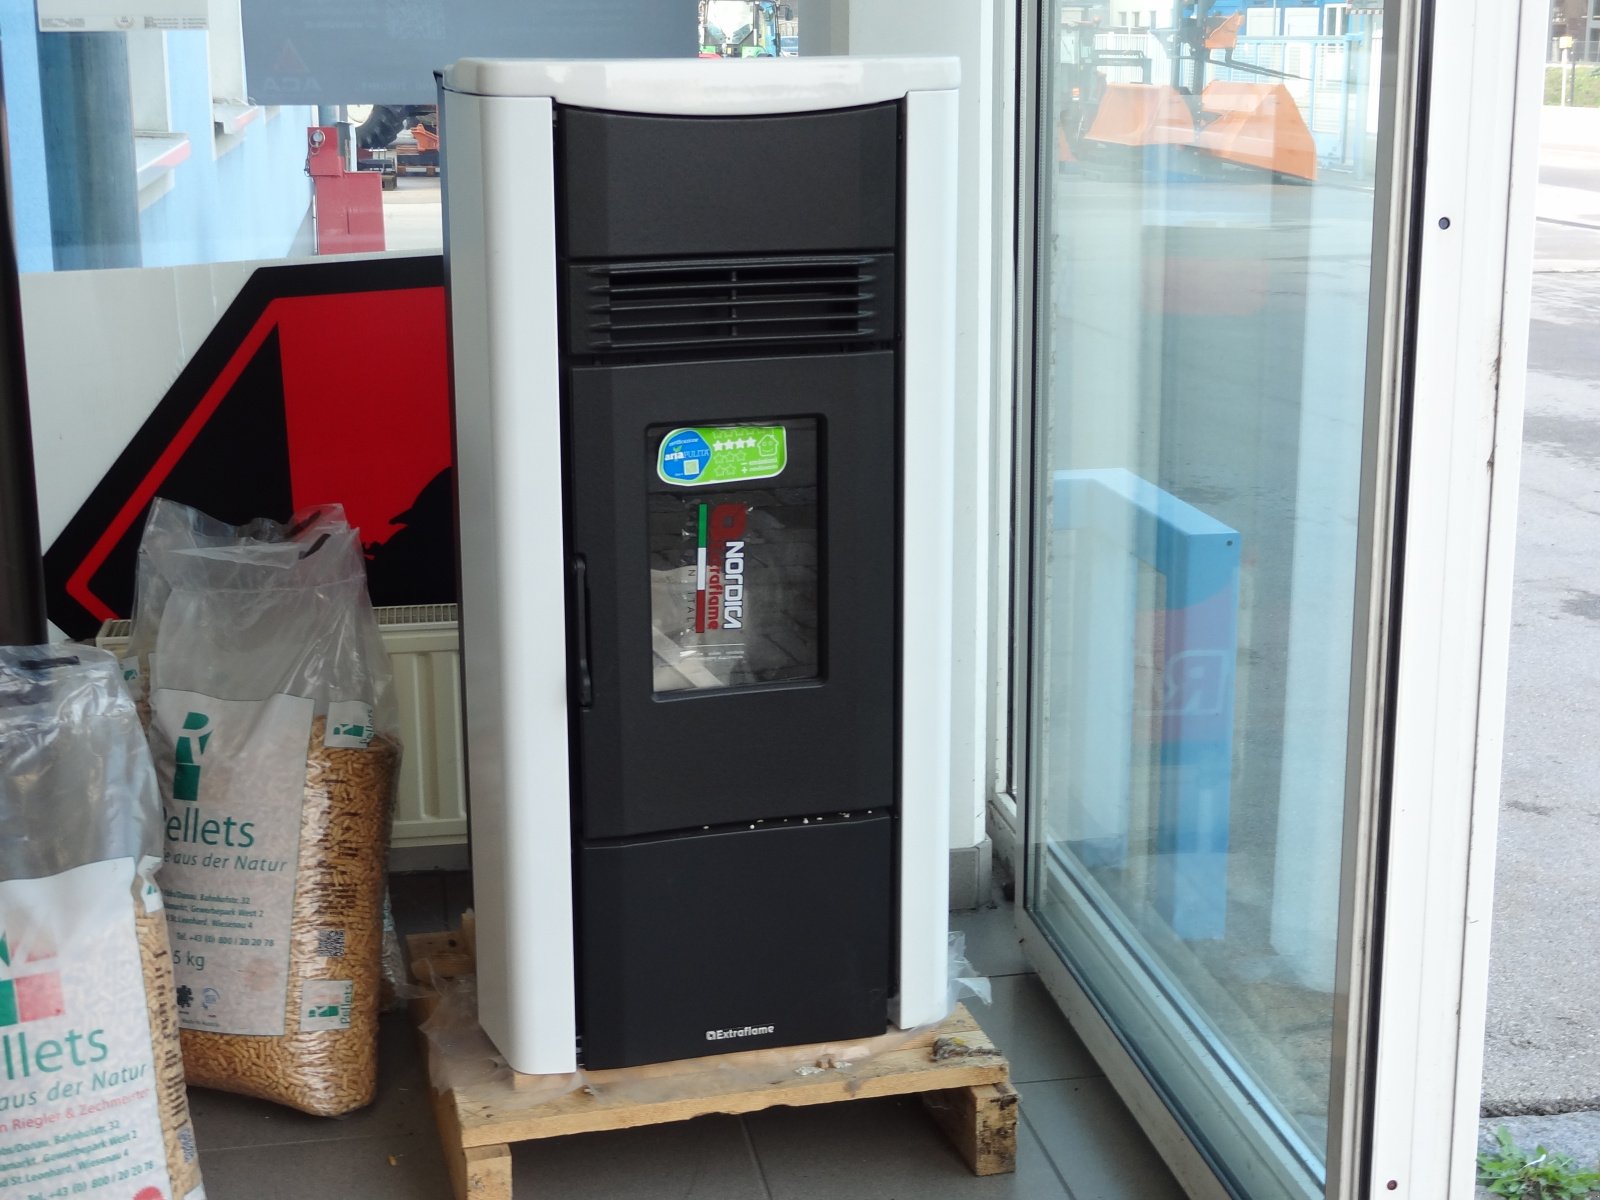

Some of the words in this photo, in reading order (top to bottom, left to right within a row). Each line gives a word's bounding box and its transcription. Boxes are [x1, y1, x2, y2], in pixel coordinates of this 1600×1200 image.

[707, 540, 723, 630] raflame
[722, 541, 745, 629] NORDICA
[163, 806, 255, 848] ellets
[173, 852, 198, 866] aus
[202, 851, 230, 869] der
[234, 855, 288, 872] Natur
[186, 950, 205, 971] kg
[716, 1025, 775, 1040] Extraflame
[2, 1029, 108, 1080] llets
[0, 1090, 37, 1111] aus
[47, 1080, 83, 1101] der
[92, 1063, 147, 1092] Natur
[12, 1112, 61, 1131] Riegler
